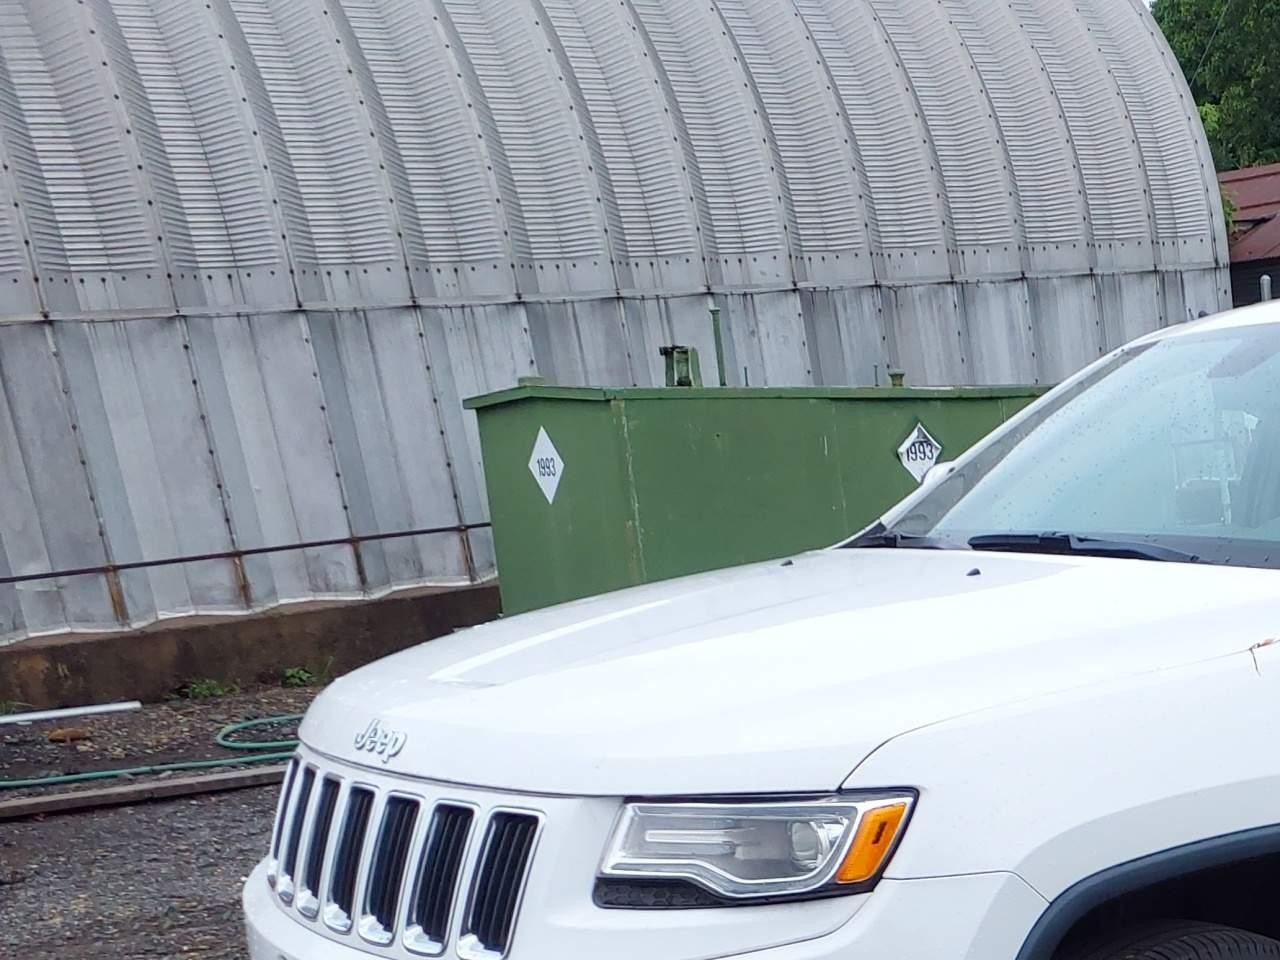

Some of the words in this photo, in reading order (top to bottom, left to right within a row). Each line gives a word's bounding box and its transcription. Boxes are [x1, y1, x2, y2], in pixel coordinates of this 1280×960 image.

[906, 442, 934, 462] 1993
[537, 457, 556, 477] 1993
[354, 718, 408, 764] Jeep
